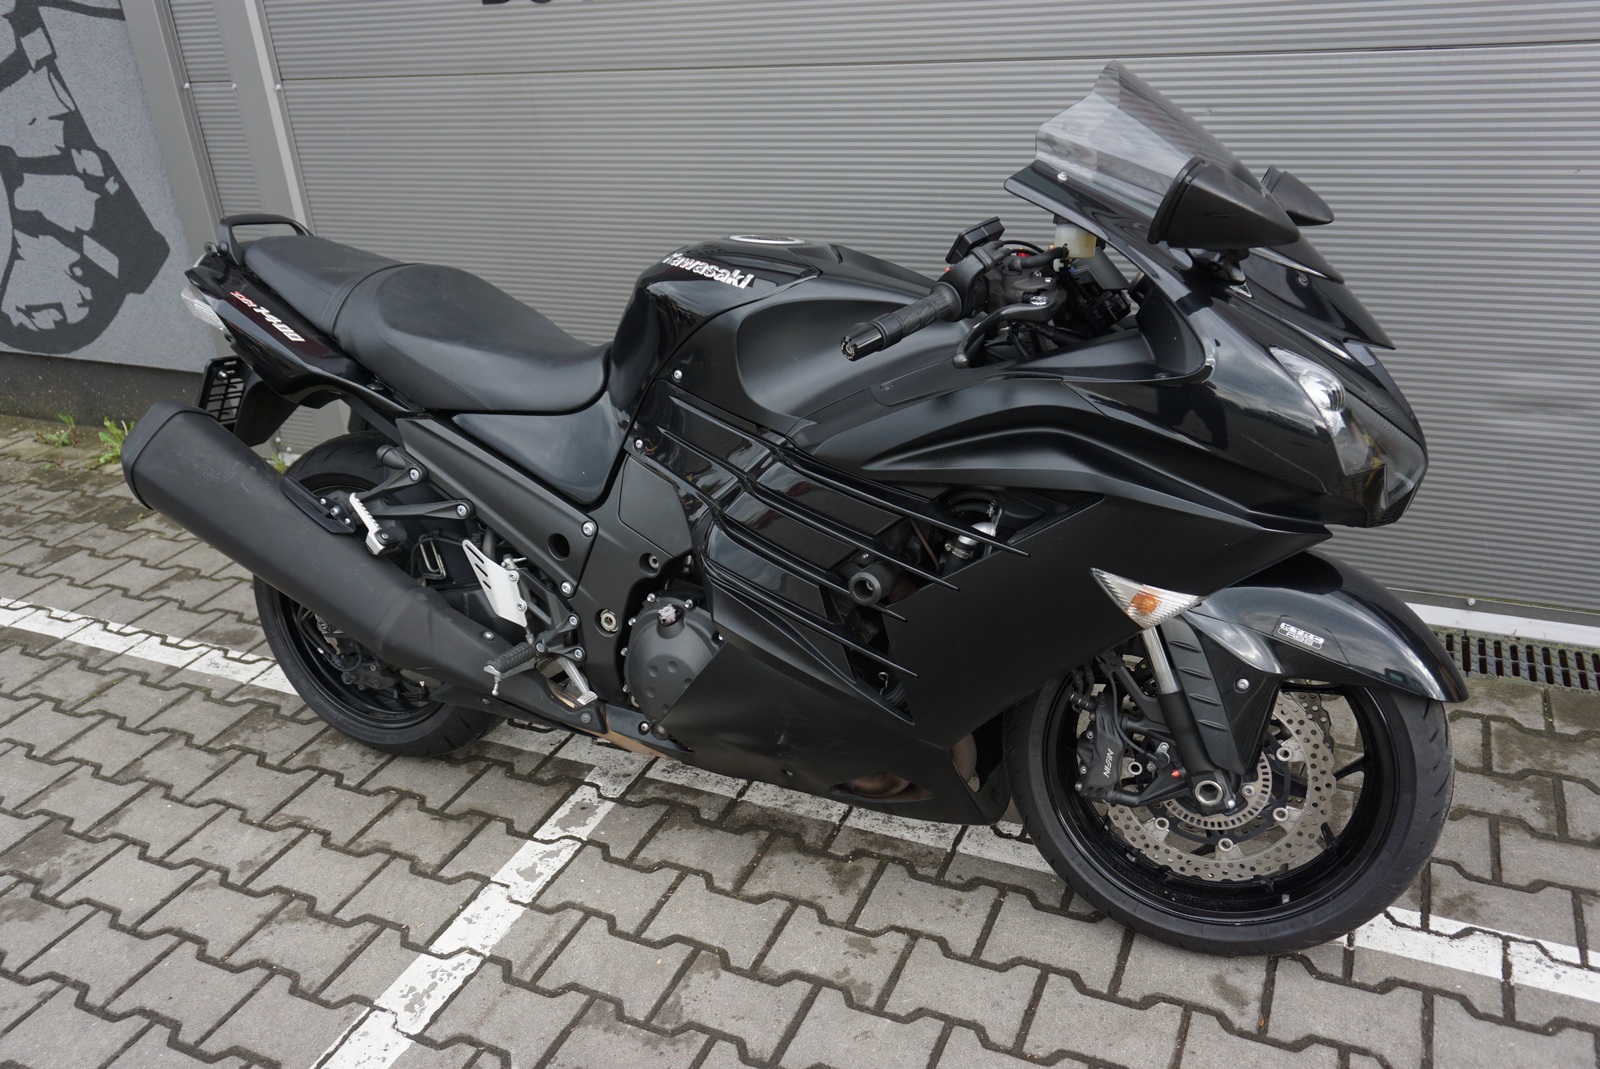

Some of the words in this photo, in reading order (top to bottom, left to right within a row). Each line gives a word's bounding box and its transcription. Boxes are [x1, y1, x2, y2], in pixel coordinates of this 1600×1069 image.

[662, 252, 755, 290] Kawasaki
[1281, 622, 1325, 645] KTRC
[1102, 747, 1115, 779] NISSIN
